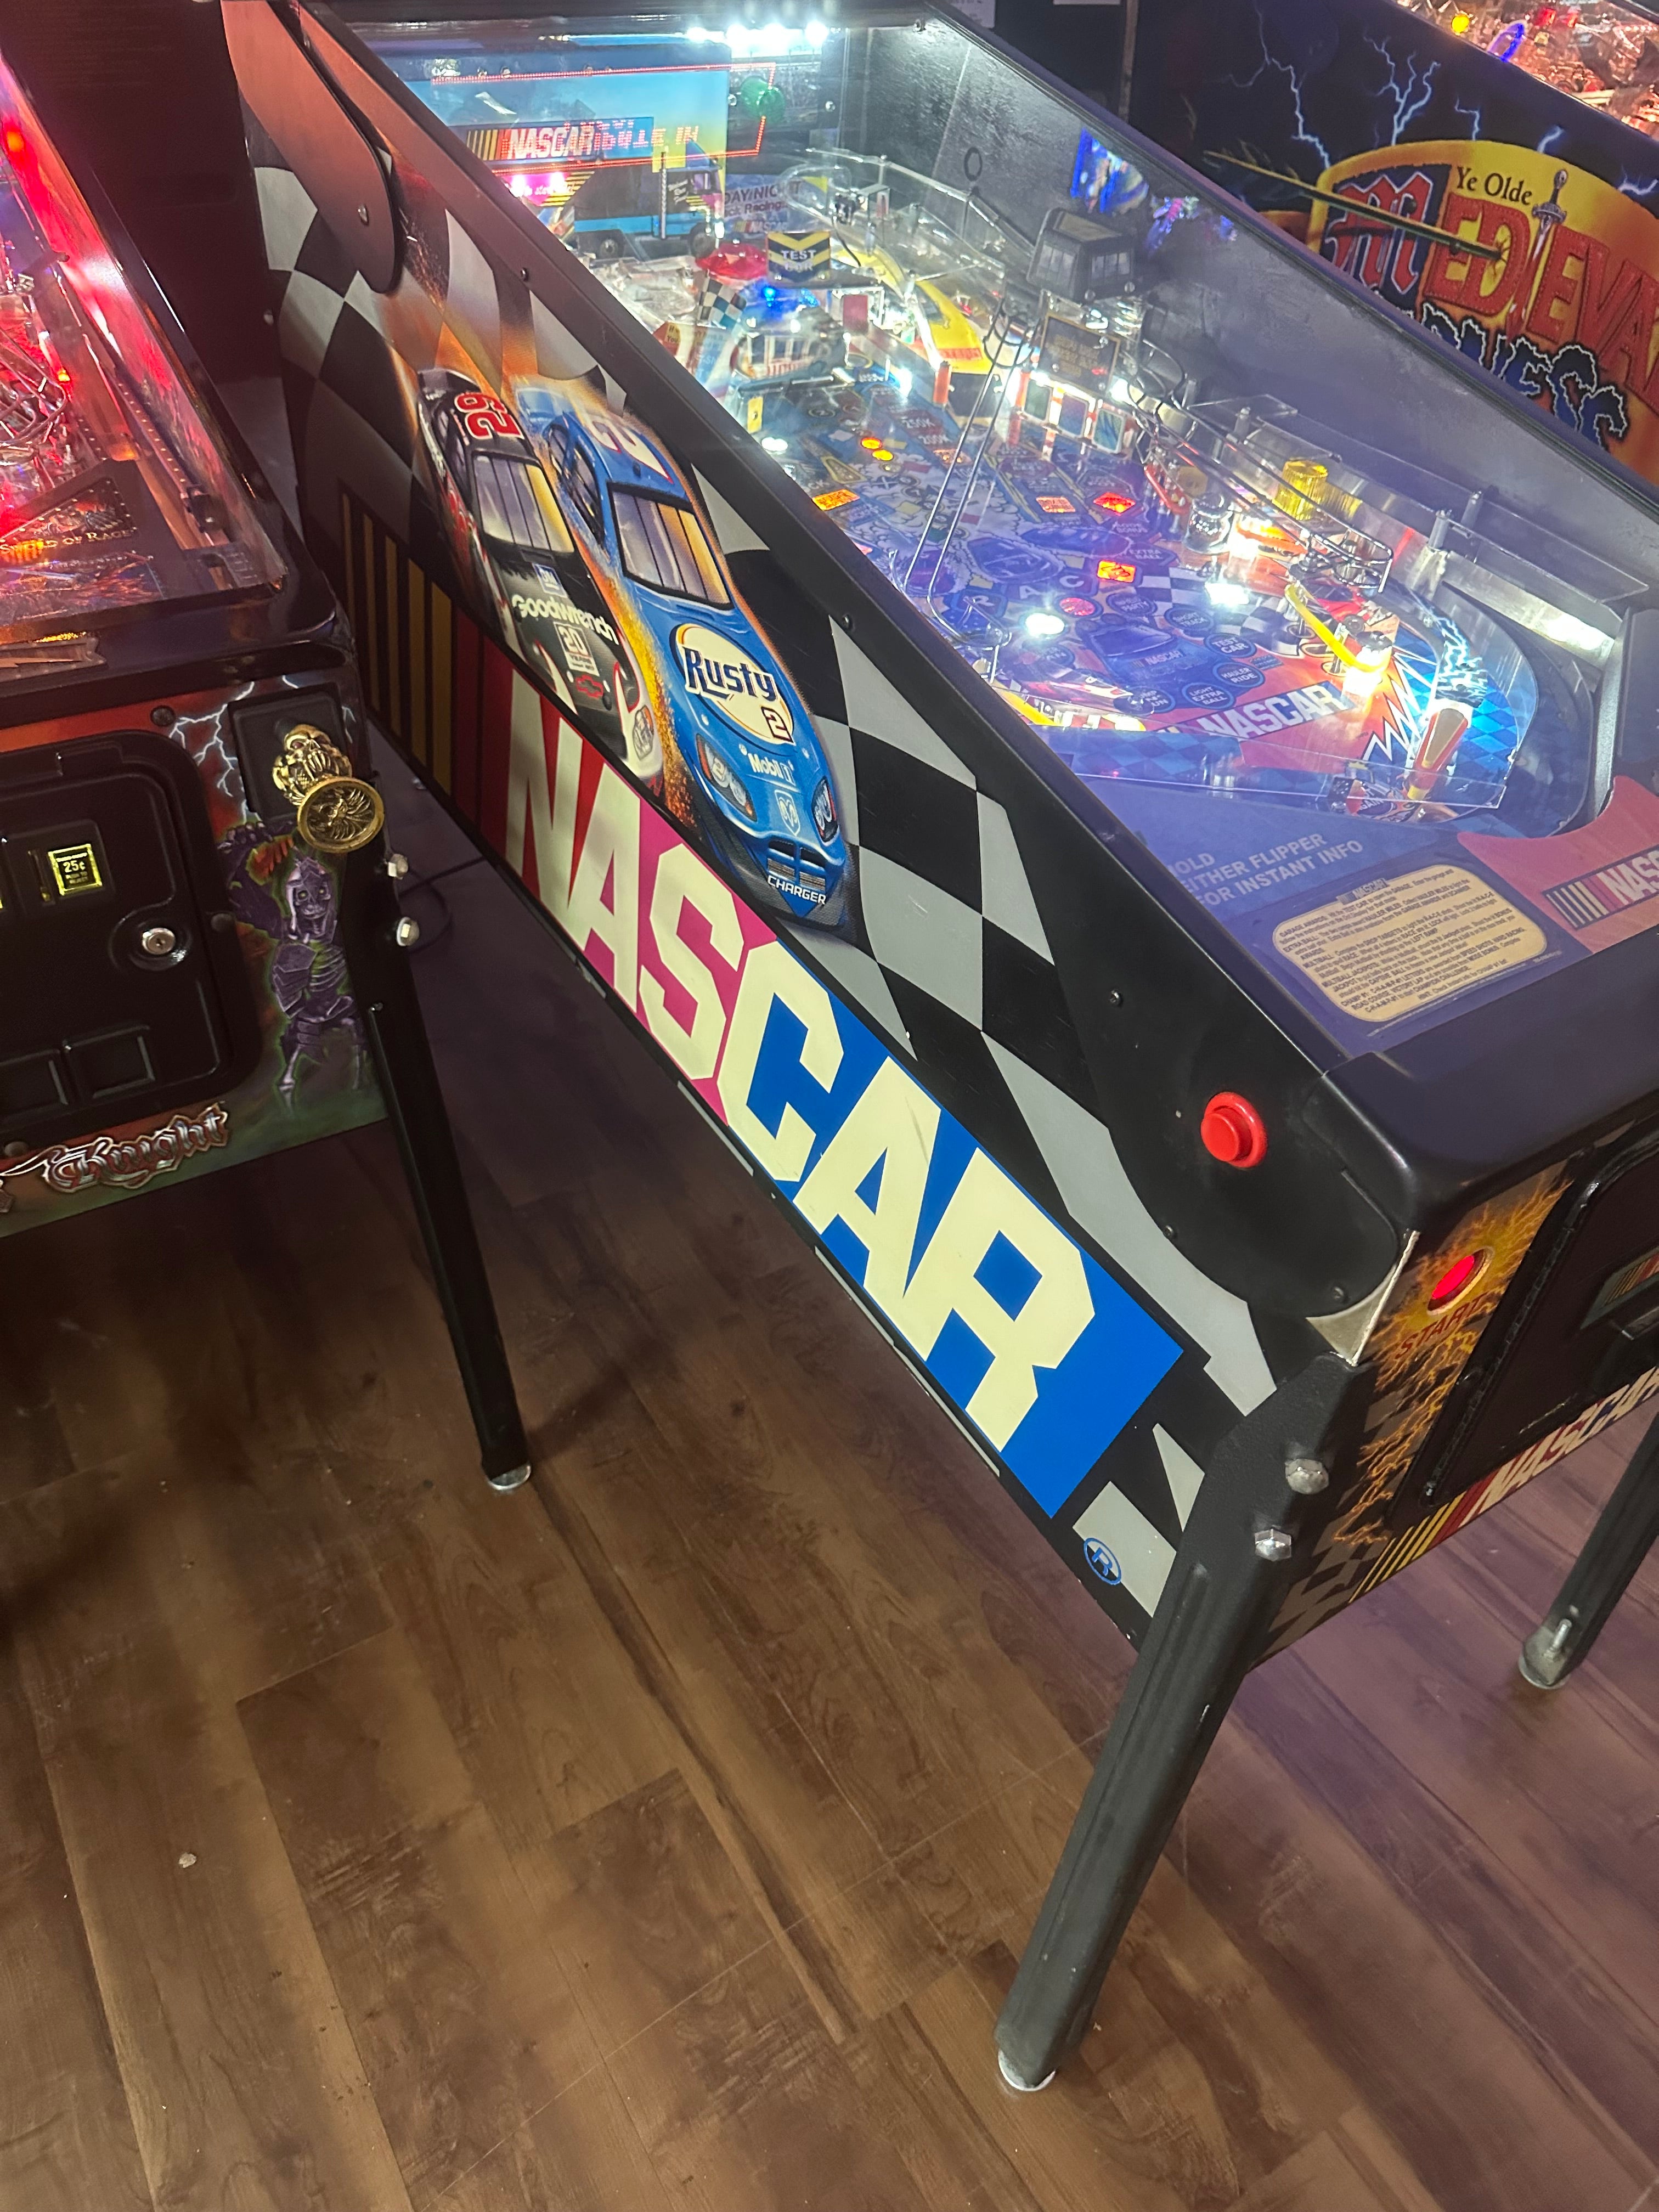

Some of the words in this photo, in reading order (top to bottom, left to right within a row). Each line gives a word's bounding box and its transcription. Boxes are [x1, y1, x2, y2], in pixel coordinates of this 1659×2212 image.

[1457, 166, 1477, 191] Ye
[1484, 172, 1533, 206] Olde
[781, 250, 816, 260] TEST
[1211, 637, 1239, 648] TEST
[1220, 642, 1249, 654] CAR
[682, 646, 778, 702] Rusty
[1230, 672, 1259, 684] RIDE
[1189, 686, 1214, 697] LIGHT
[1192, 690, 1225, 703] EXTRA
[1201, 695, 1228, 706] BALL
[1196, 684, 1348, 742] NASCAR
[760, 706, 794, 743] 2
[747, 753, 783, 778] Mobil
[1248, 833, 1328, 870] FLIPPER
[1234, 856, 1316, 896] INSTANT
[1319, 839, 1363, 865] INFO
[768, 874, 827, 904] CHARGER
[1355, 900, 1369, 908] CAR
[1409, 933, 1425, 943] LEFT
[1331, 978, 1358, 992] JACKPOT
[1368, 972, 1392, 985] CAPTIVE
[1390, 966, 1407, 976] BALL
[506, 669, 1095, 1452] NASCAR
[1395, 1296, 1482, 1360] START
